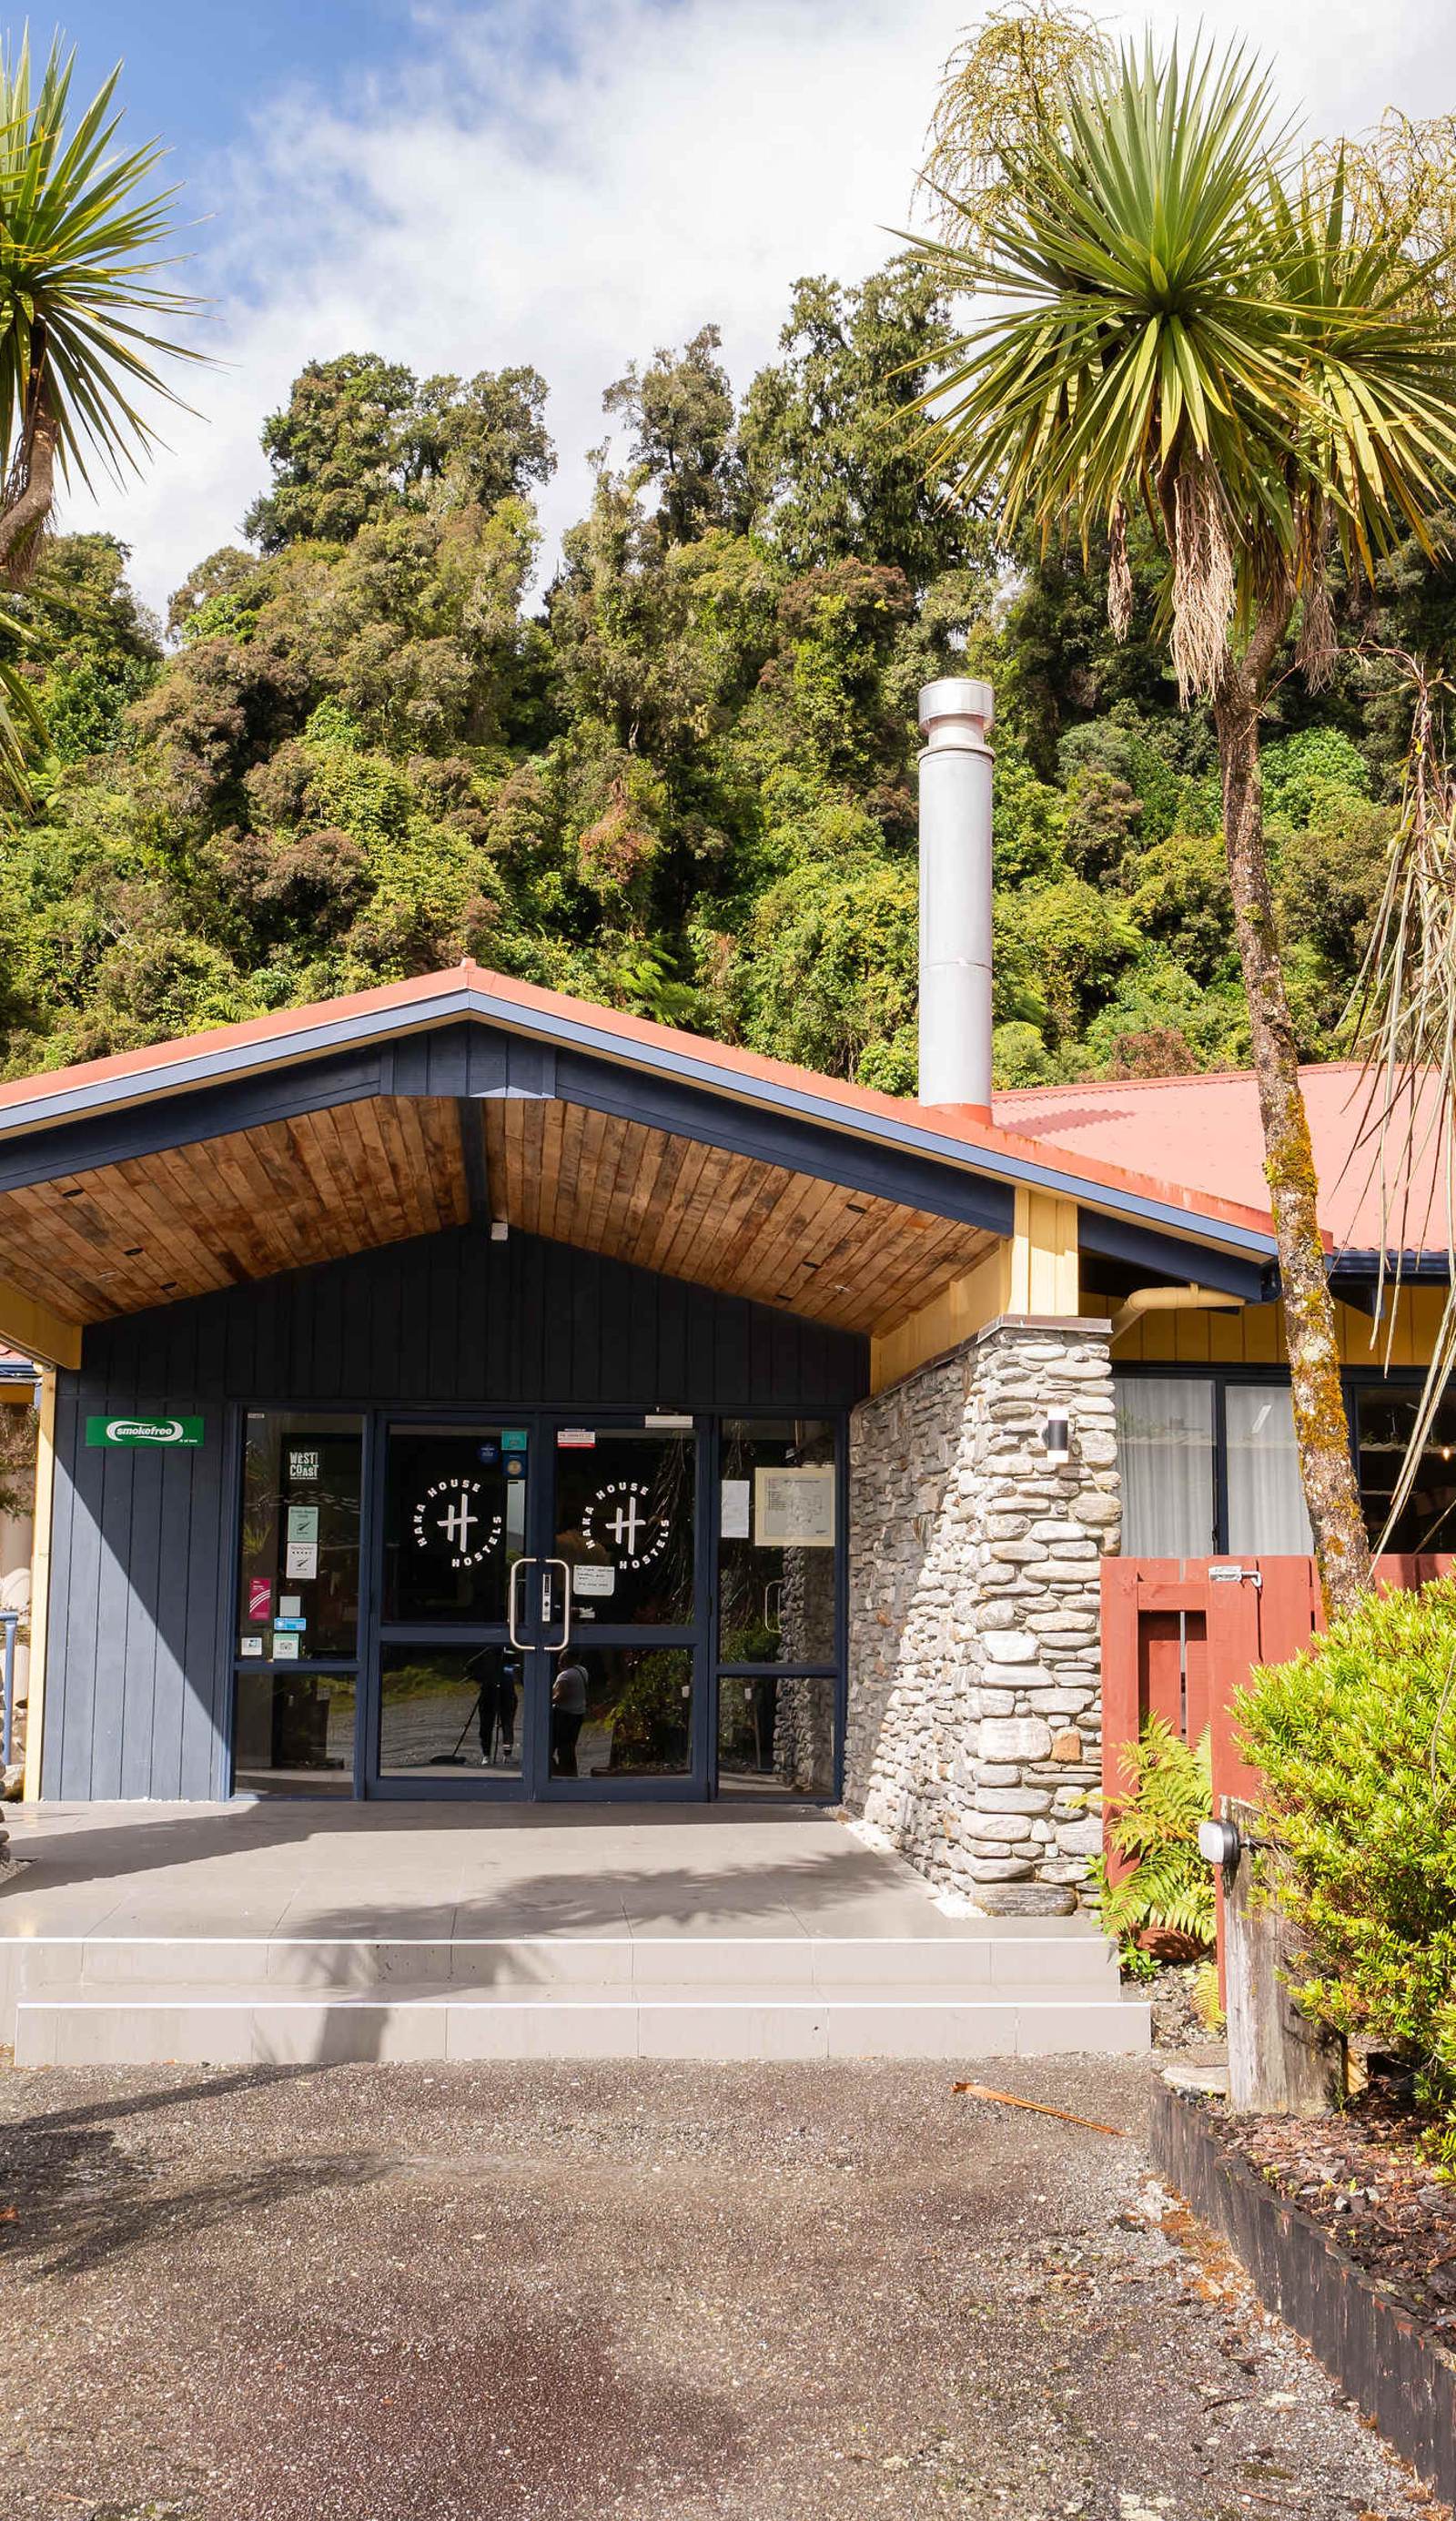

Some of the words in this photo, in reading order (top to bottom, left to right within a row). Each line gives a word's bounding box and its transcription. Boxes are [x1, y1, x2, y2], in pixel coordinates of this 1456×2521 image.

[116, 1426, 173, 1435] smokefree
[289, 1463, 319, 1477] COAST
[427, 1479, 481, 1498] HOUSE
[595, 1482, 649, 1501] HOUSE
[413, 1503, 428, 1547] HAKA
[581, 1506, 596, 1550] HAKA
[451, 1515, 502, 1568] HOSTELS
[619, 1519, 670, 1570] HOSTELS
